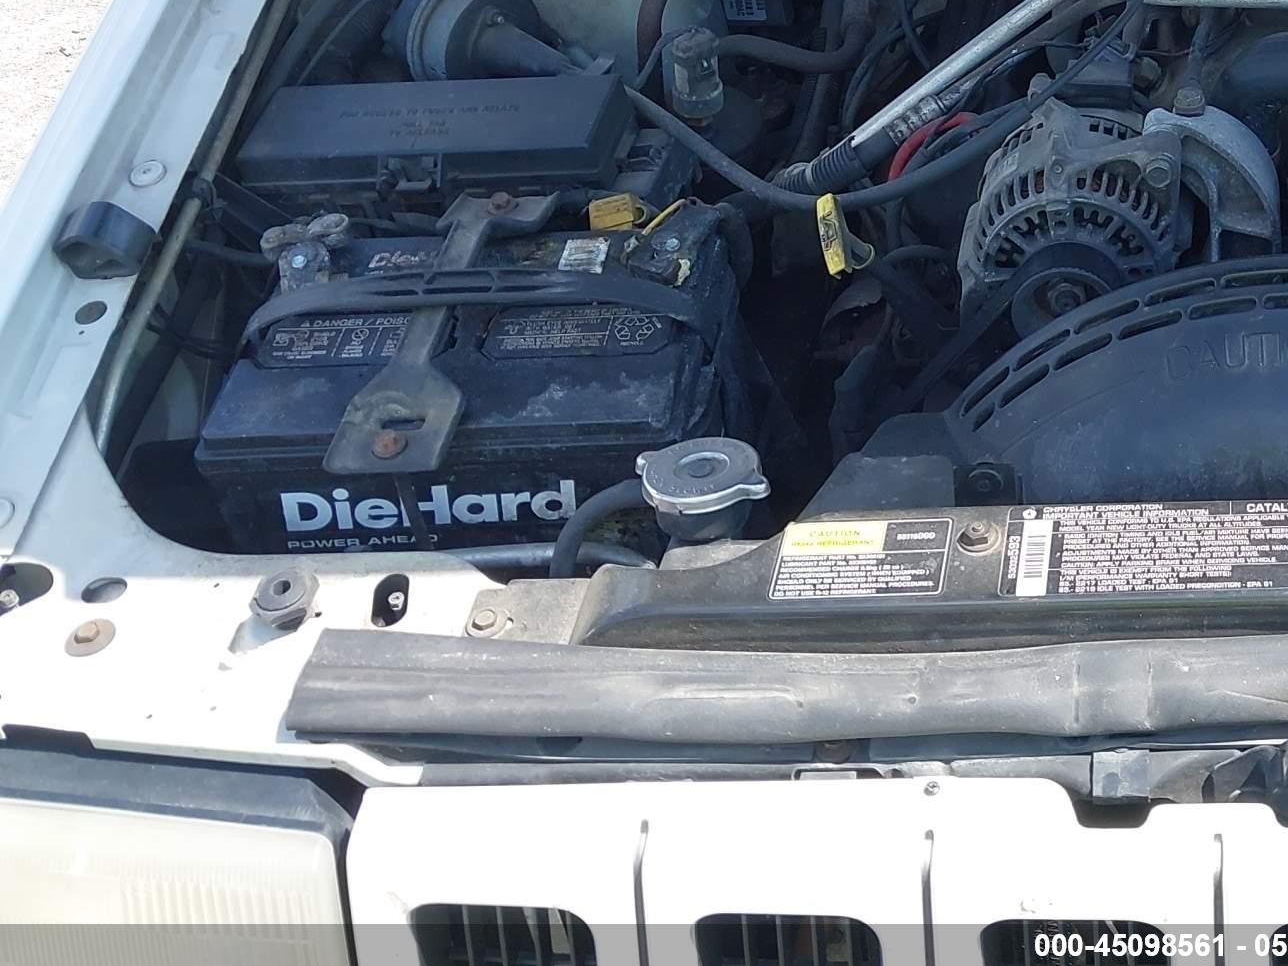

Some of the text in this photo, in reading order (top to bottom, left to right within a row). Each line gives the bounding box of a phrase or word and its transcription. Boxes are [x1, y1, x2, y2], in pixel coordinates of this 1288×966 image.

[315, 318, 364, 326] DANGER
[280, 480, 576, 532] DieHard
[1042, 503, 1163, 513] CHRYSLER CORPORATION
[1042, 508, 1209, 520] IMPORTANT VEHICLE INFORMATION
[288, 538, 360, 550] POWER
